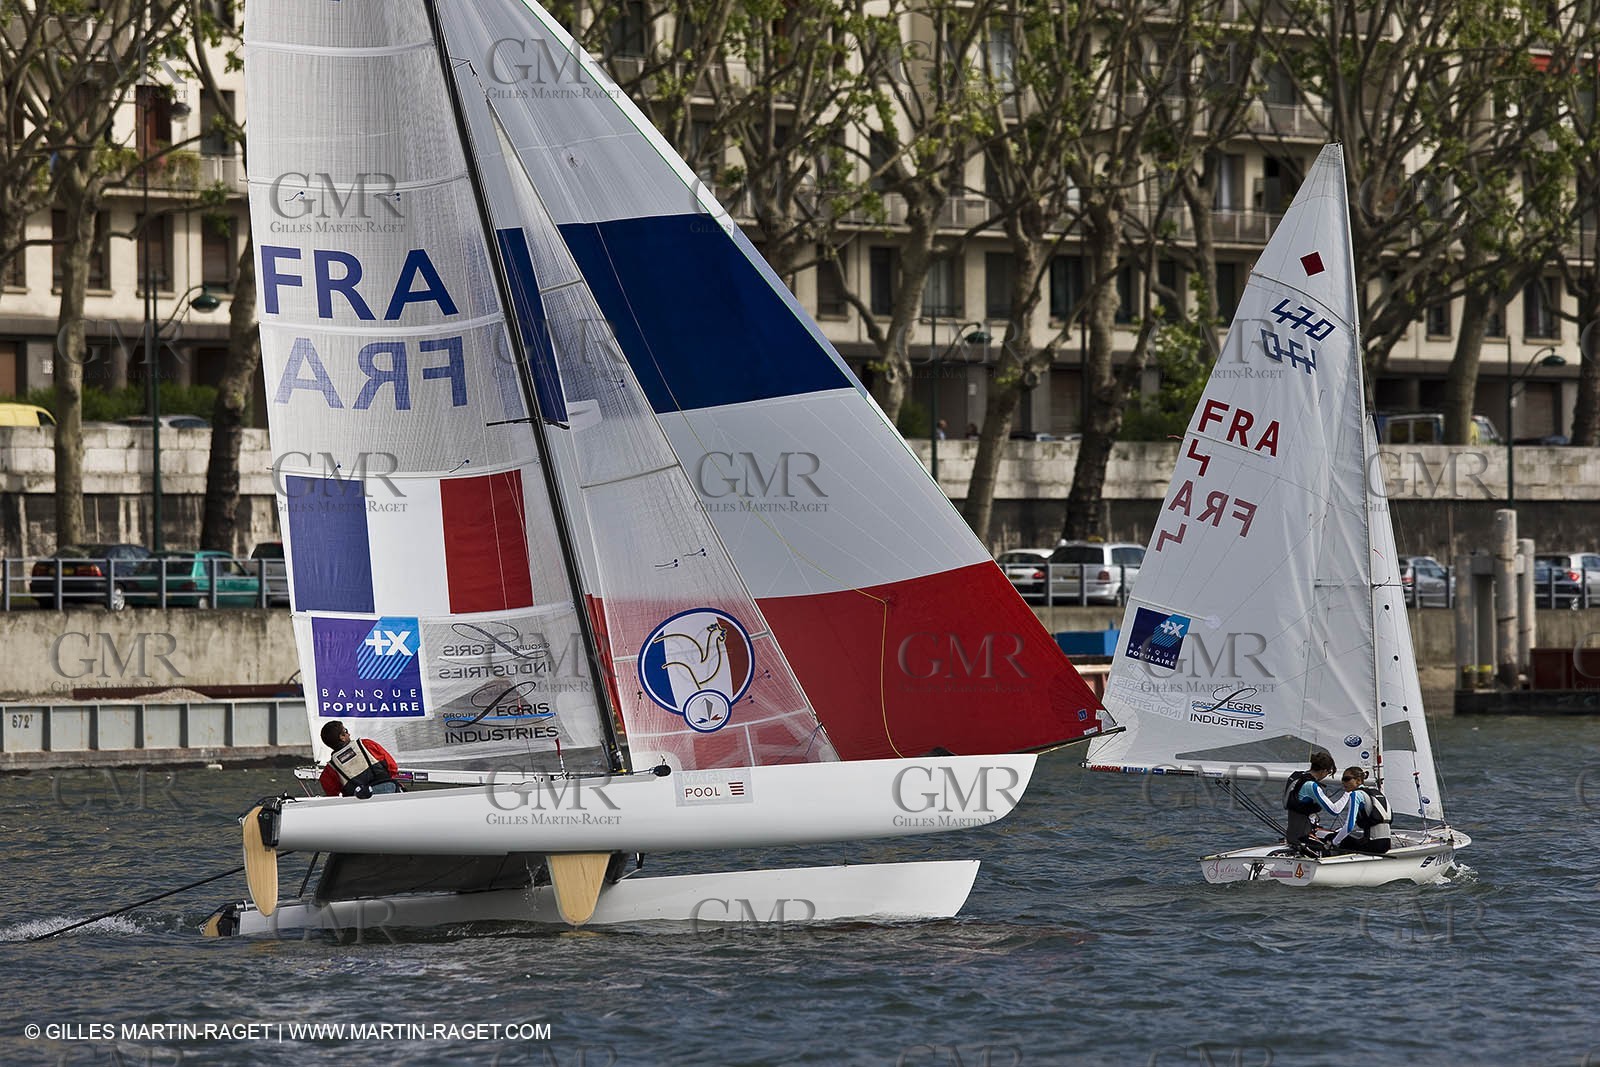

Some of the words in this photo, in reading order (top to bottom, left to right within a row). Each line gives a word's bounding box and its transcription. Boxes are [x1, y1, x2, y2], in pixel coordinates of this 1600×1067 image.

[261, 245, 459, 321] FRA
[1270, 298, 1336, 342] 470
[1197, 399, 1280, 457] FRA
[1128, 649, 1175, 667] POPULAIRE
[322, 689, 417, 699] BANQUE
[323, 702, 420, 712] POPULAIRE
[1190, 714, 1264, 730] INDUSTRIES
[445, 726, 559, 744] INDUSTRIES
[685, 787, 720, 798] POOL
